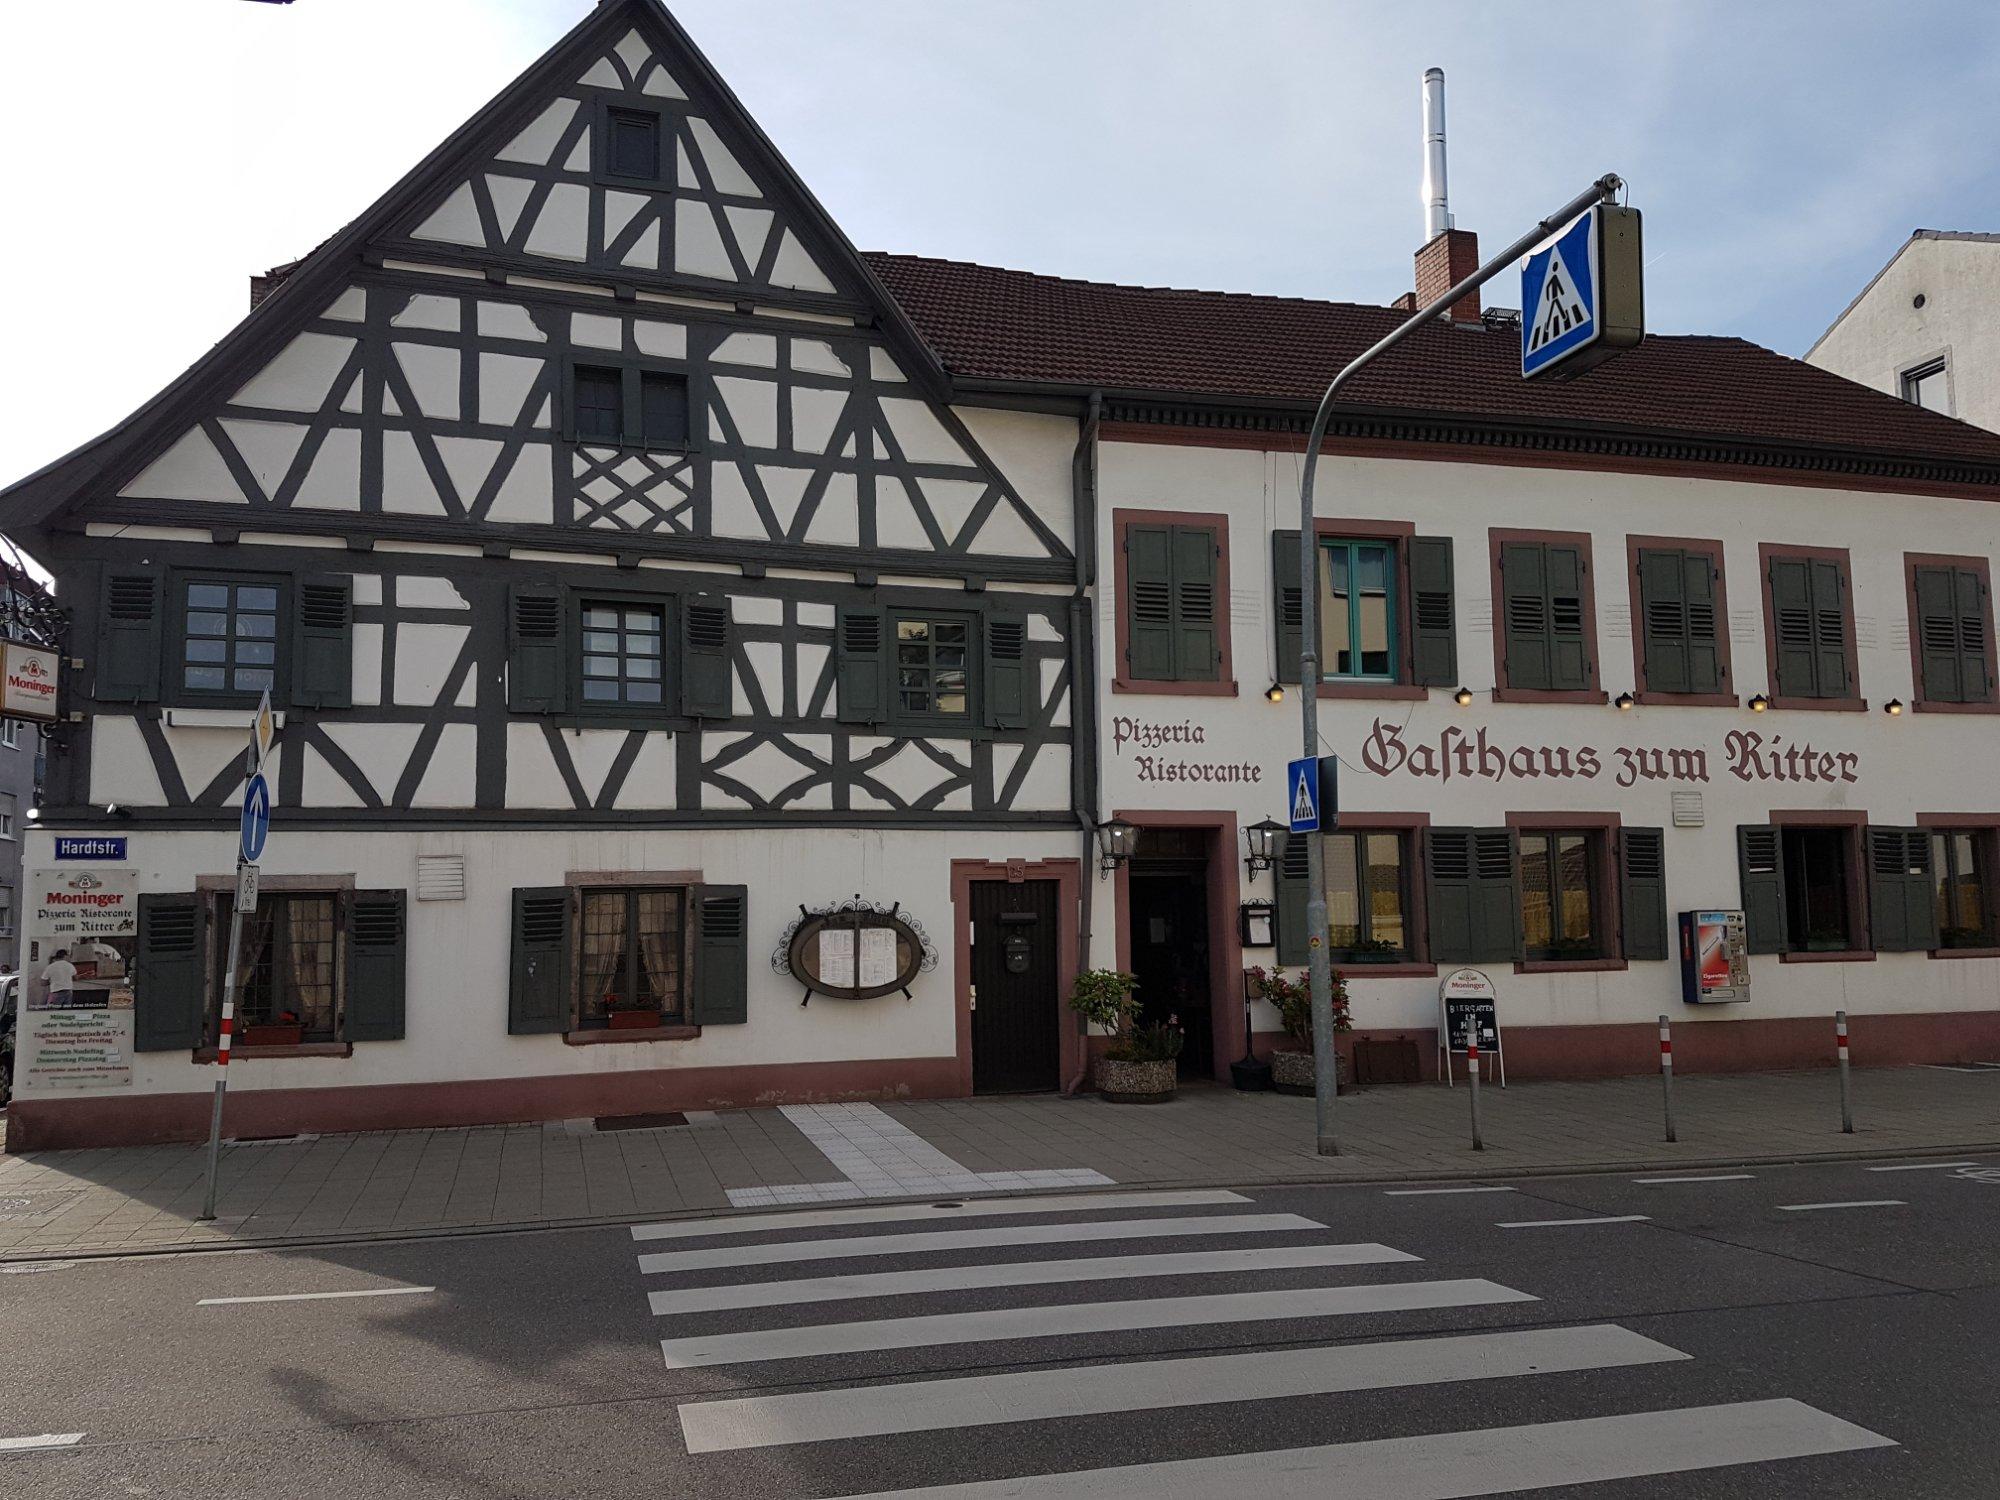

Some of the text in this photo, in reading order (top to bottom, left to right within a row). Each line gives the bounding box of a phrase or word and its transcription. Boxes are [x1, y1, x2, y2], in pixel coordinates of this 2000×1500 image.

[8, 675, 56, 695] Moninger
[1113, 716, 1205, 755] Pizzeria
[1614, 747, 1710, 787] zum
[1724, 730, 1859, 783] Ritter
[1135, 755, 1261, 783] Ristorante
[61, 840, 119, 854] Hardtstr.
[46, 890, 124, 907] Moninger
[37, 908, 132, 921] Pizzeria Ristorante
[53, 921, 115, 934] zum Ritter
[1451, 982, 1486, 990] Moninger
[1460, 1020, 1483, 1029] HF
